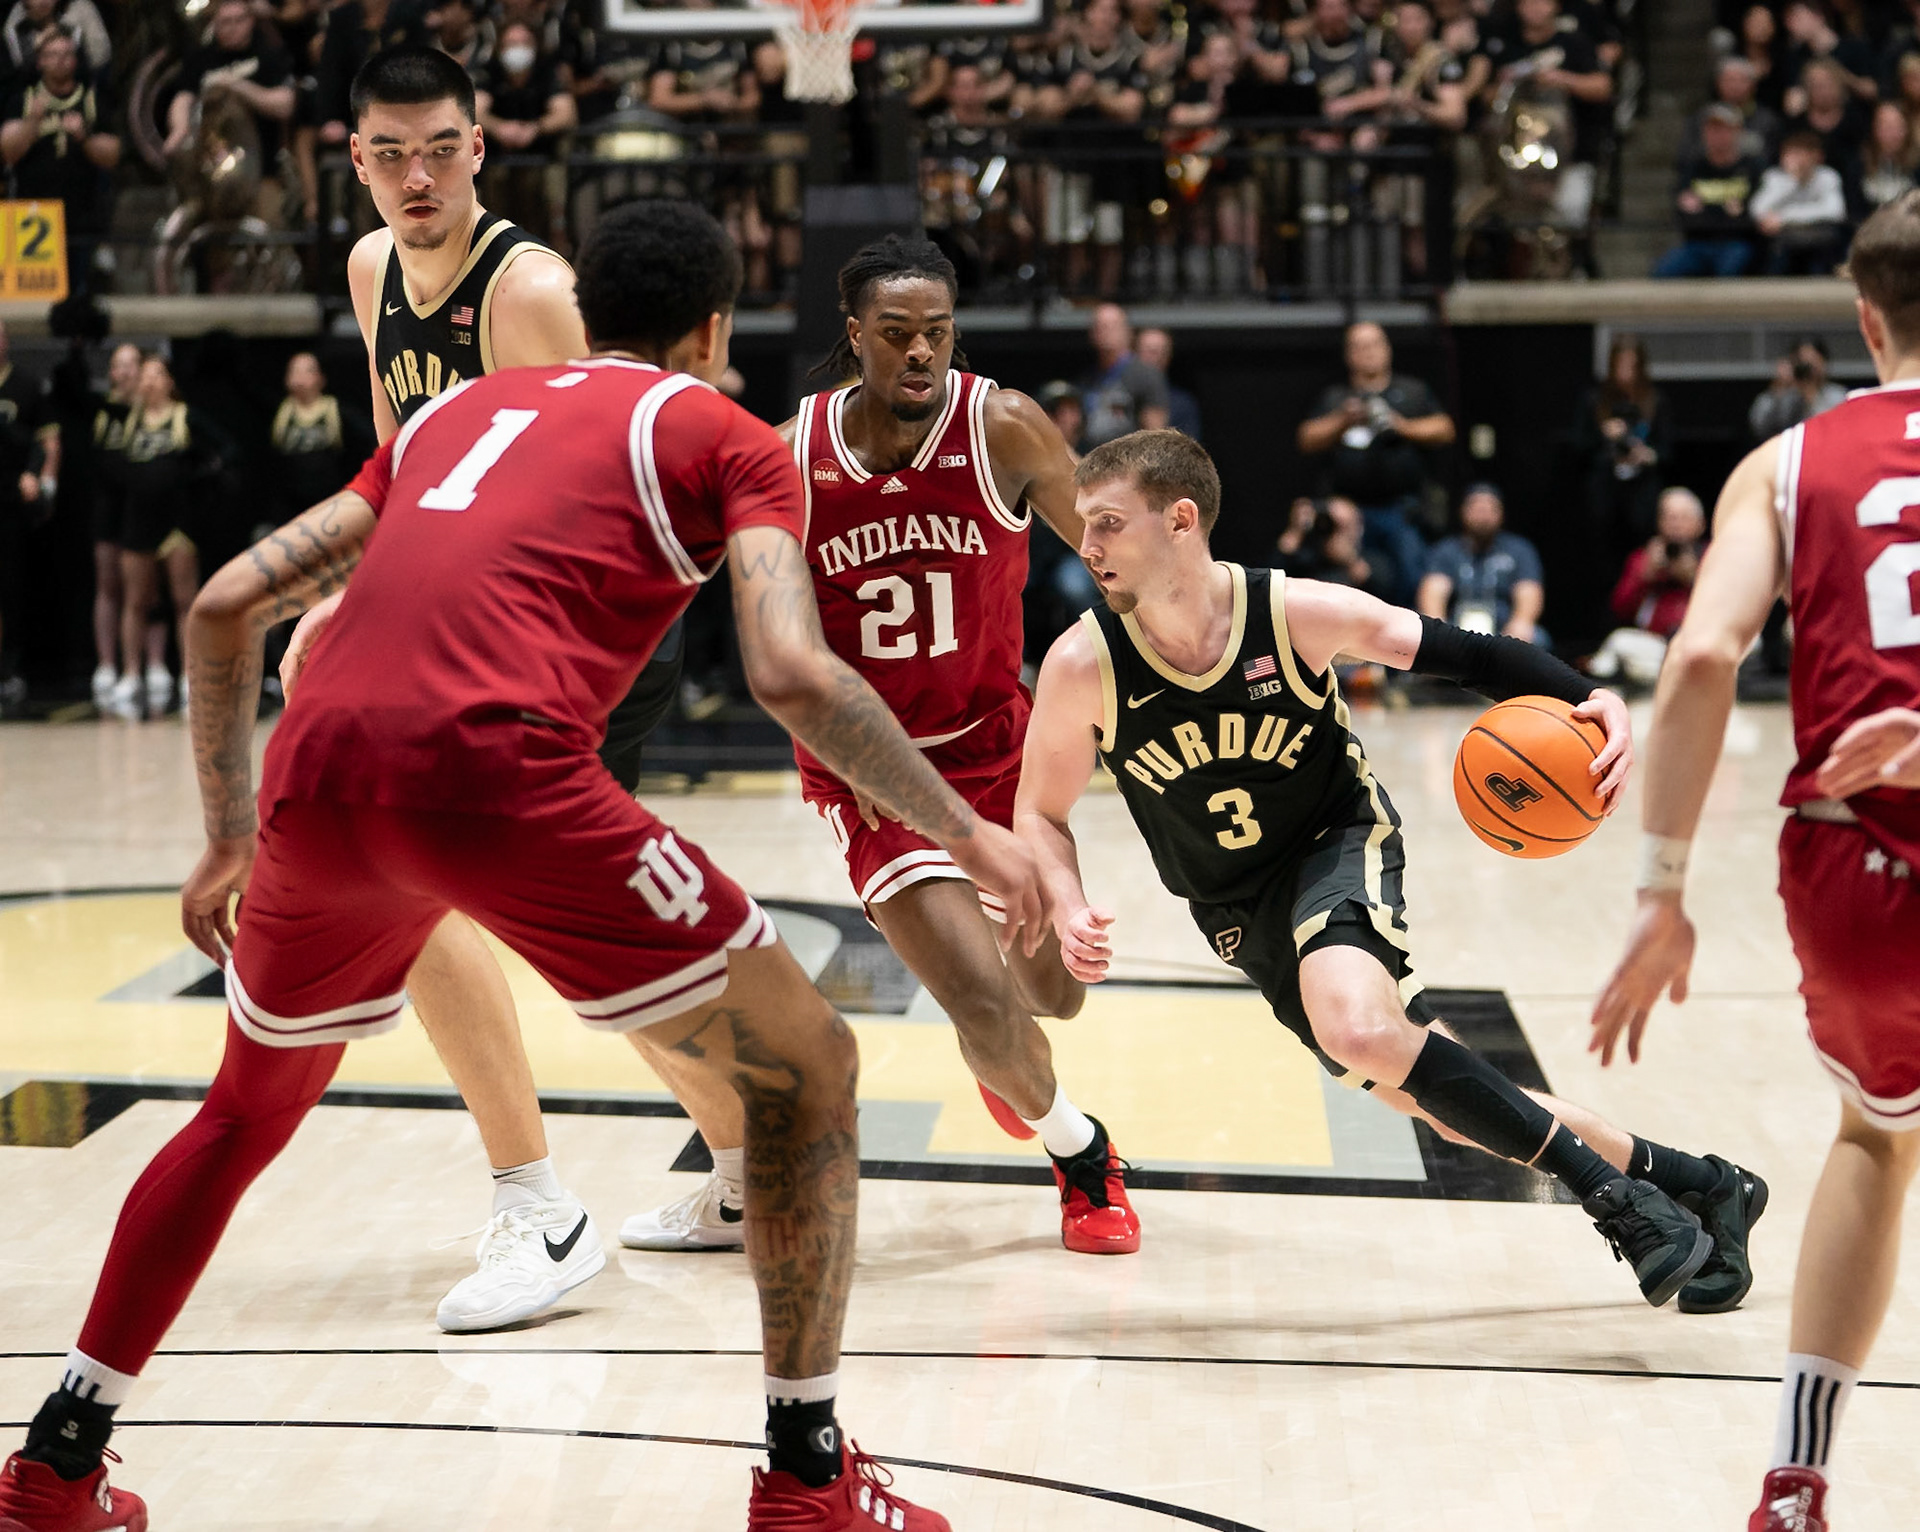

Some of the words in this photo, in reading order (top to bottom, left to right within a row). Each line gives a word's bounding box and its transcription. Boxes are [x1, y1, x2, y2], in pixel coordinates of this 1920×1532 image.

[20, 215, 53, 261] 2
[417, 408, 539, 511] 1
[813, 469, 840, 482] RMK
[880, 485, 909, 495] adidas
[818, 514, 989, 577] INDIANA
[856, 571, 960, 660] 21
[1123, 712, 1314, 796] PURDUE
[1206, 787, 1263, 851] 3
[1484, 772, 1545, 813] P
[1215, 926, 1242, 962] P
